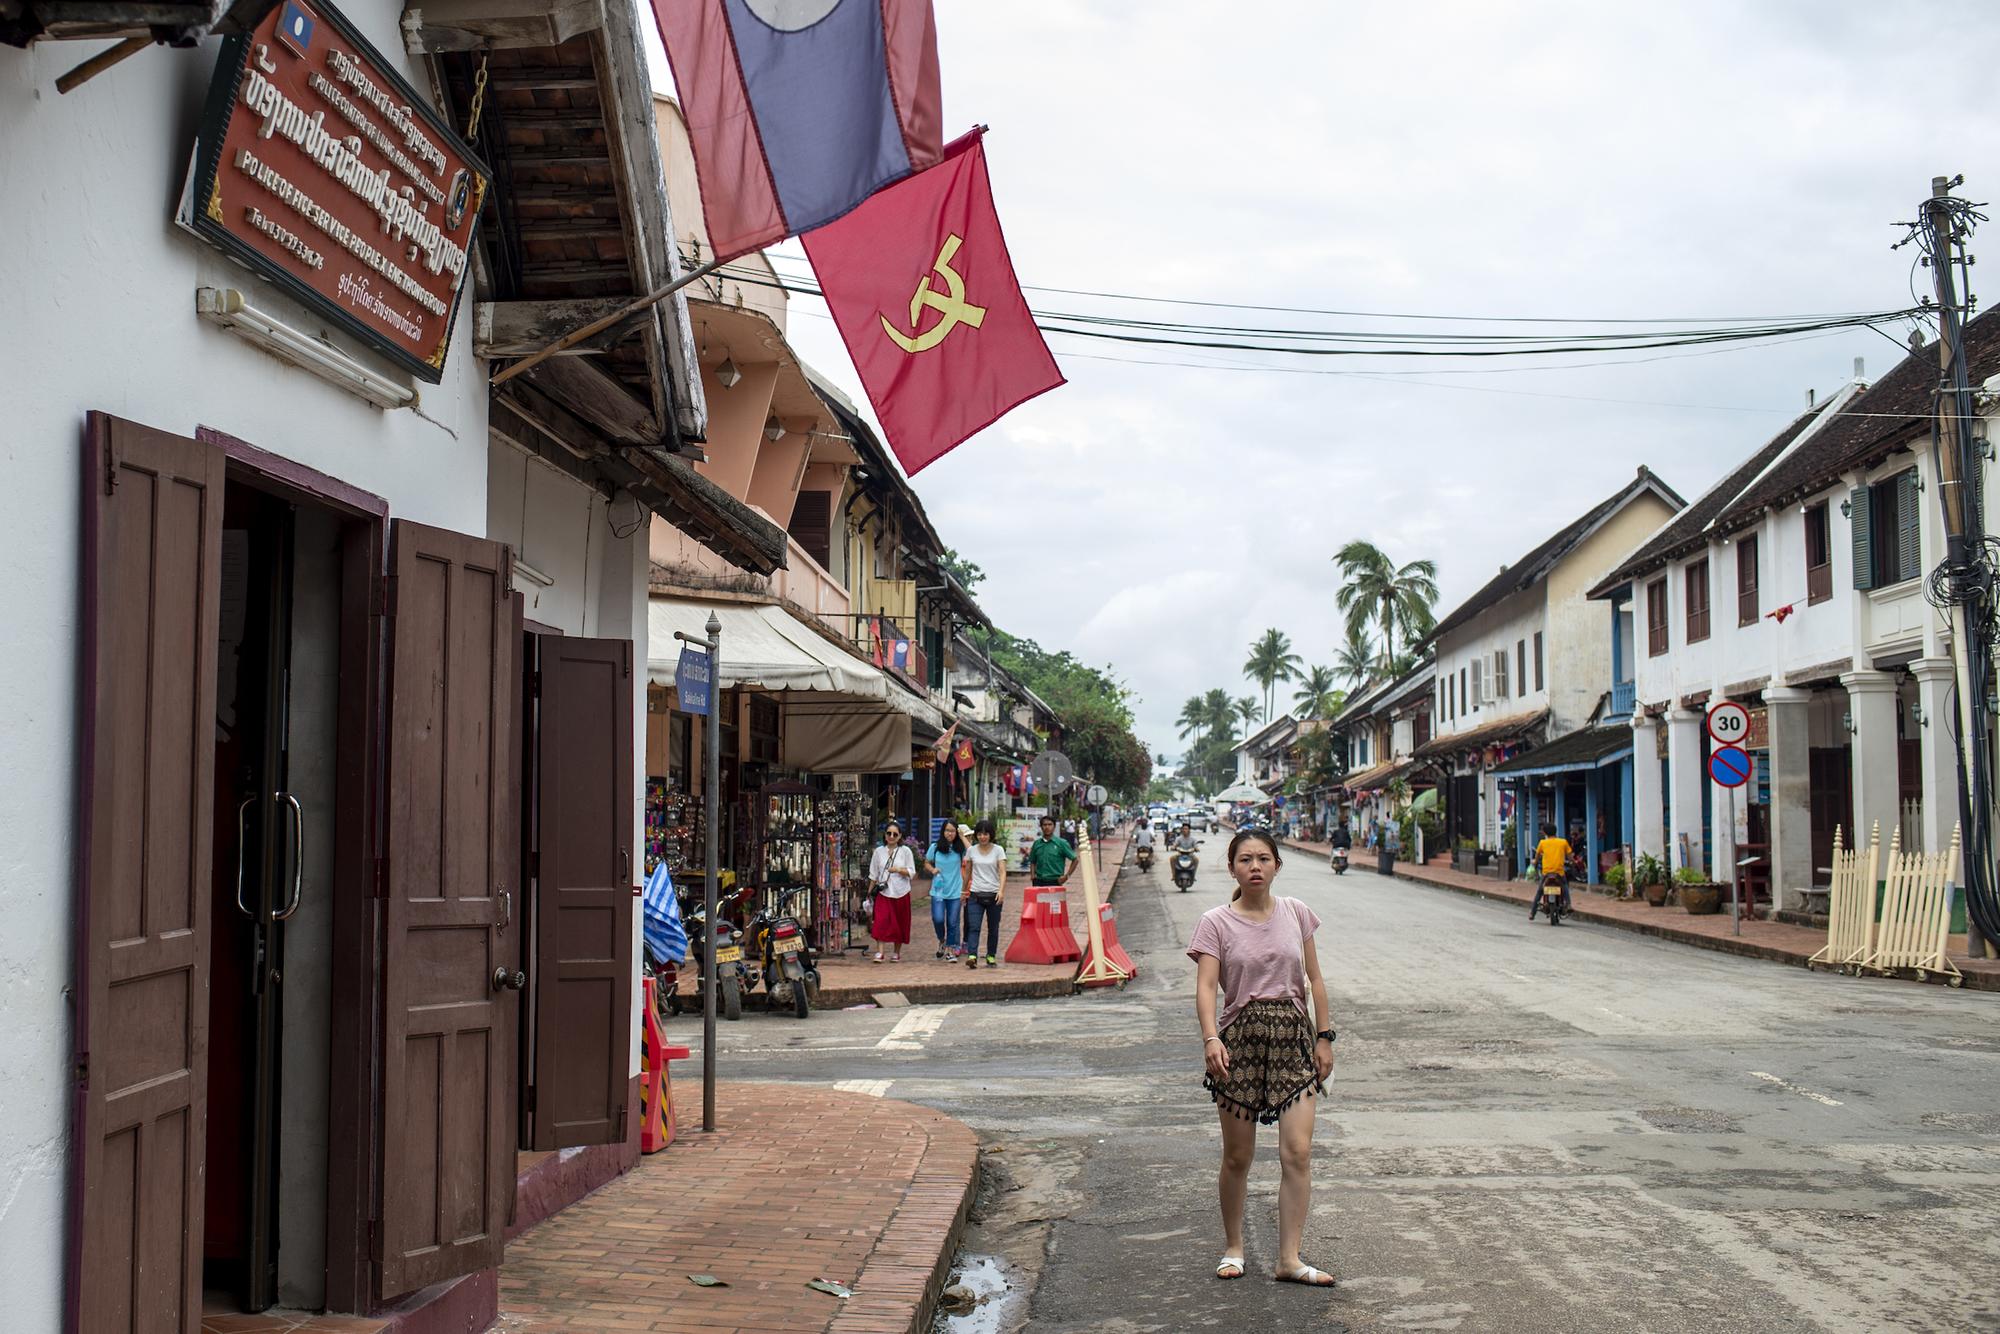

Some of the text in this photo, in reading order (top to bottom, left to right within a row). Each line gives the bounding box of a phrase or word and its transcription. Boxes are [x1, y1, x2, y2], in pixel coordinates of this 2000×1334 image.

[315, 73, 446, 206] POLICE CONTROL OF LUANG PRABANG DISTRICT
[242, 150, 280, 192] POLICE
[350, 233, 382, 268] PEOPLE
[1718, 716, 1741, 731] 30
